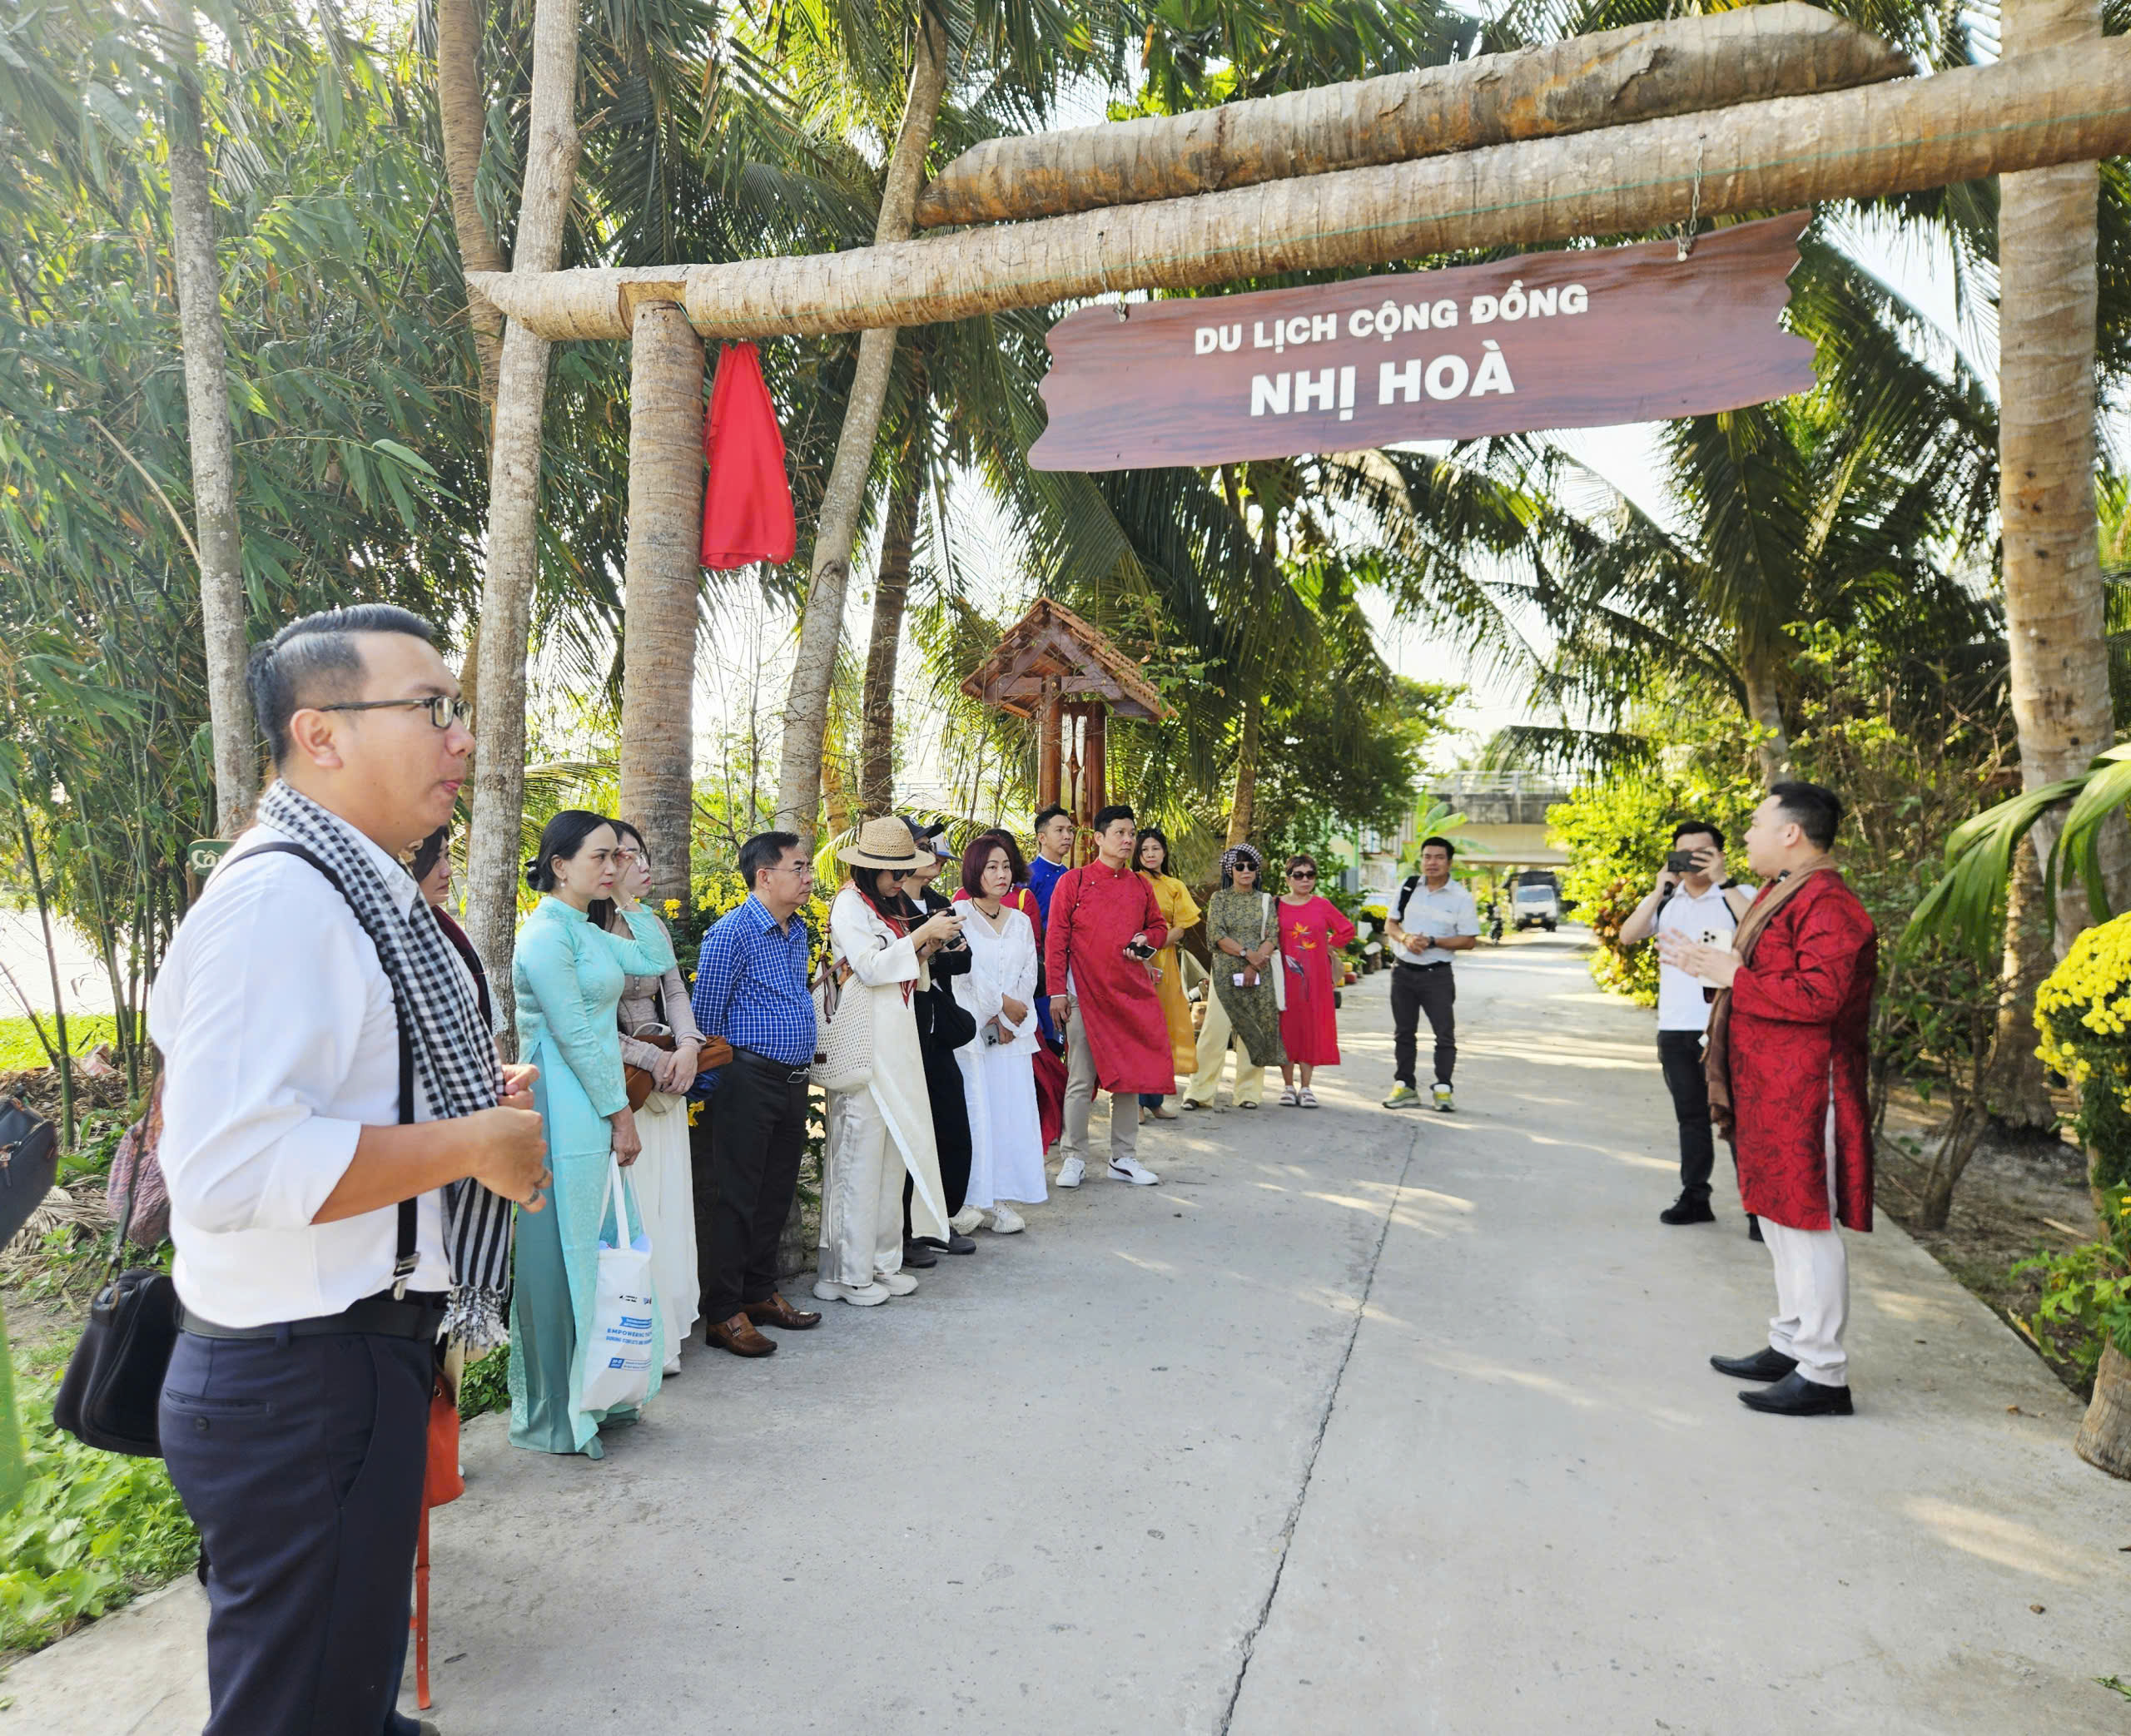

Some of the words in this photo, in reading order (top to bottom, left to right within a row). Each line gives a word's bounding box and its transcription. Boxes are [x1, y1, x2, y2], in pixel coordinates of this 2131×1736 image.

[1195, 324, 1242, 355] DU
[1254, 313, 1338, 354] LỊCH
[1349, 300, 1458, 342] CỘNG
[1469, 279, 1588, 325] ĐỒNG
[1250, 365, 1356, 421] NHỊ
[1378, 339, 1515, 405] HOÀ
